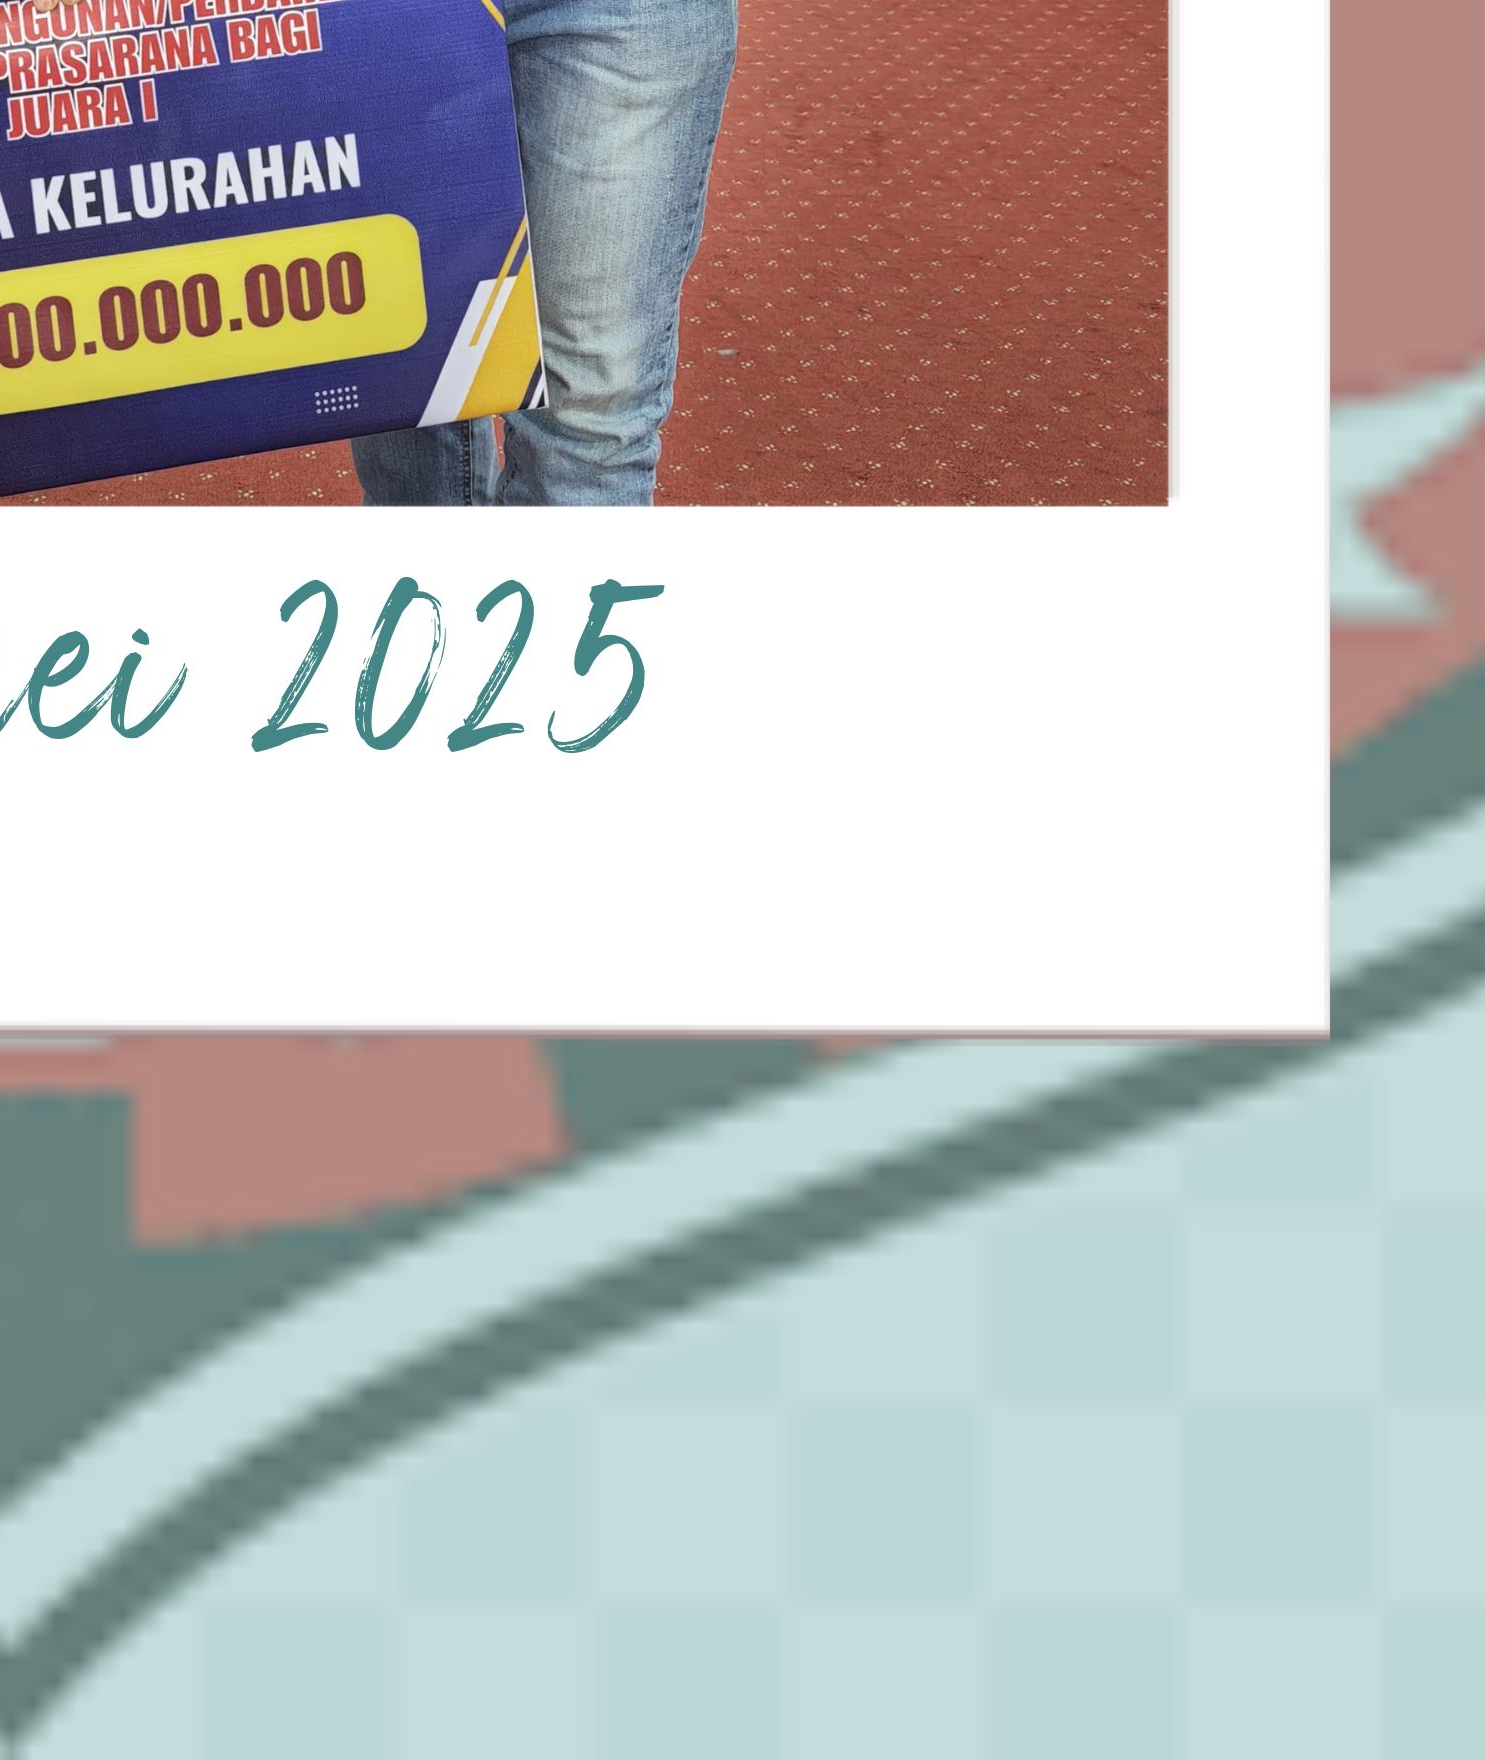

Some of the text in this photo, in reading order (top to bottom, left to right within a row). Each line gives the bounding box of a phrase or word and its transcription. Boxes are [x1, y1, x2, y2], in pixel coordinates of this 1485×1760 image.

[229, 7, 322, 63] BAGI
[6, 80, 158, 141] JUARA I
[29, 133, 362, 235] KELURAHAN
